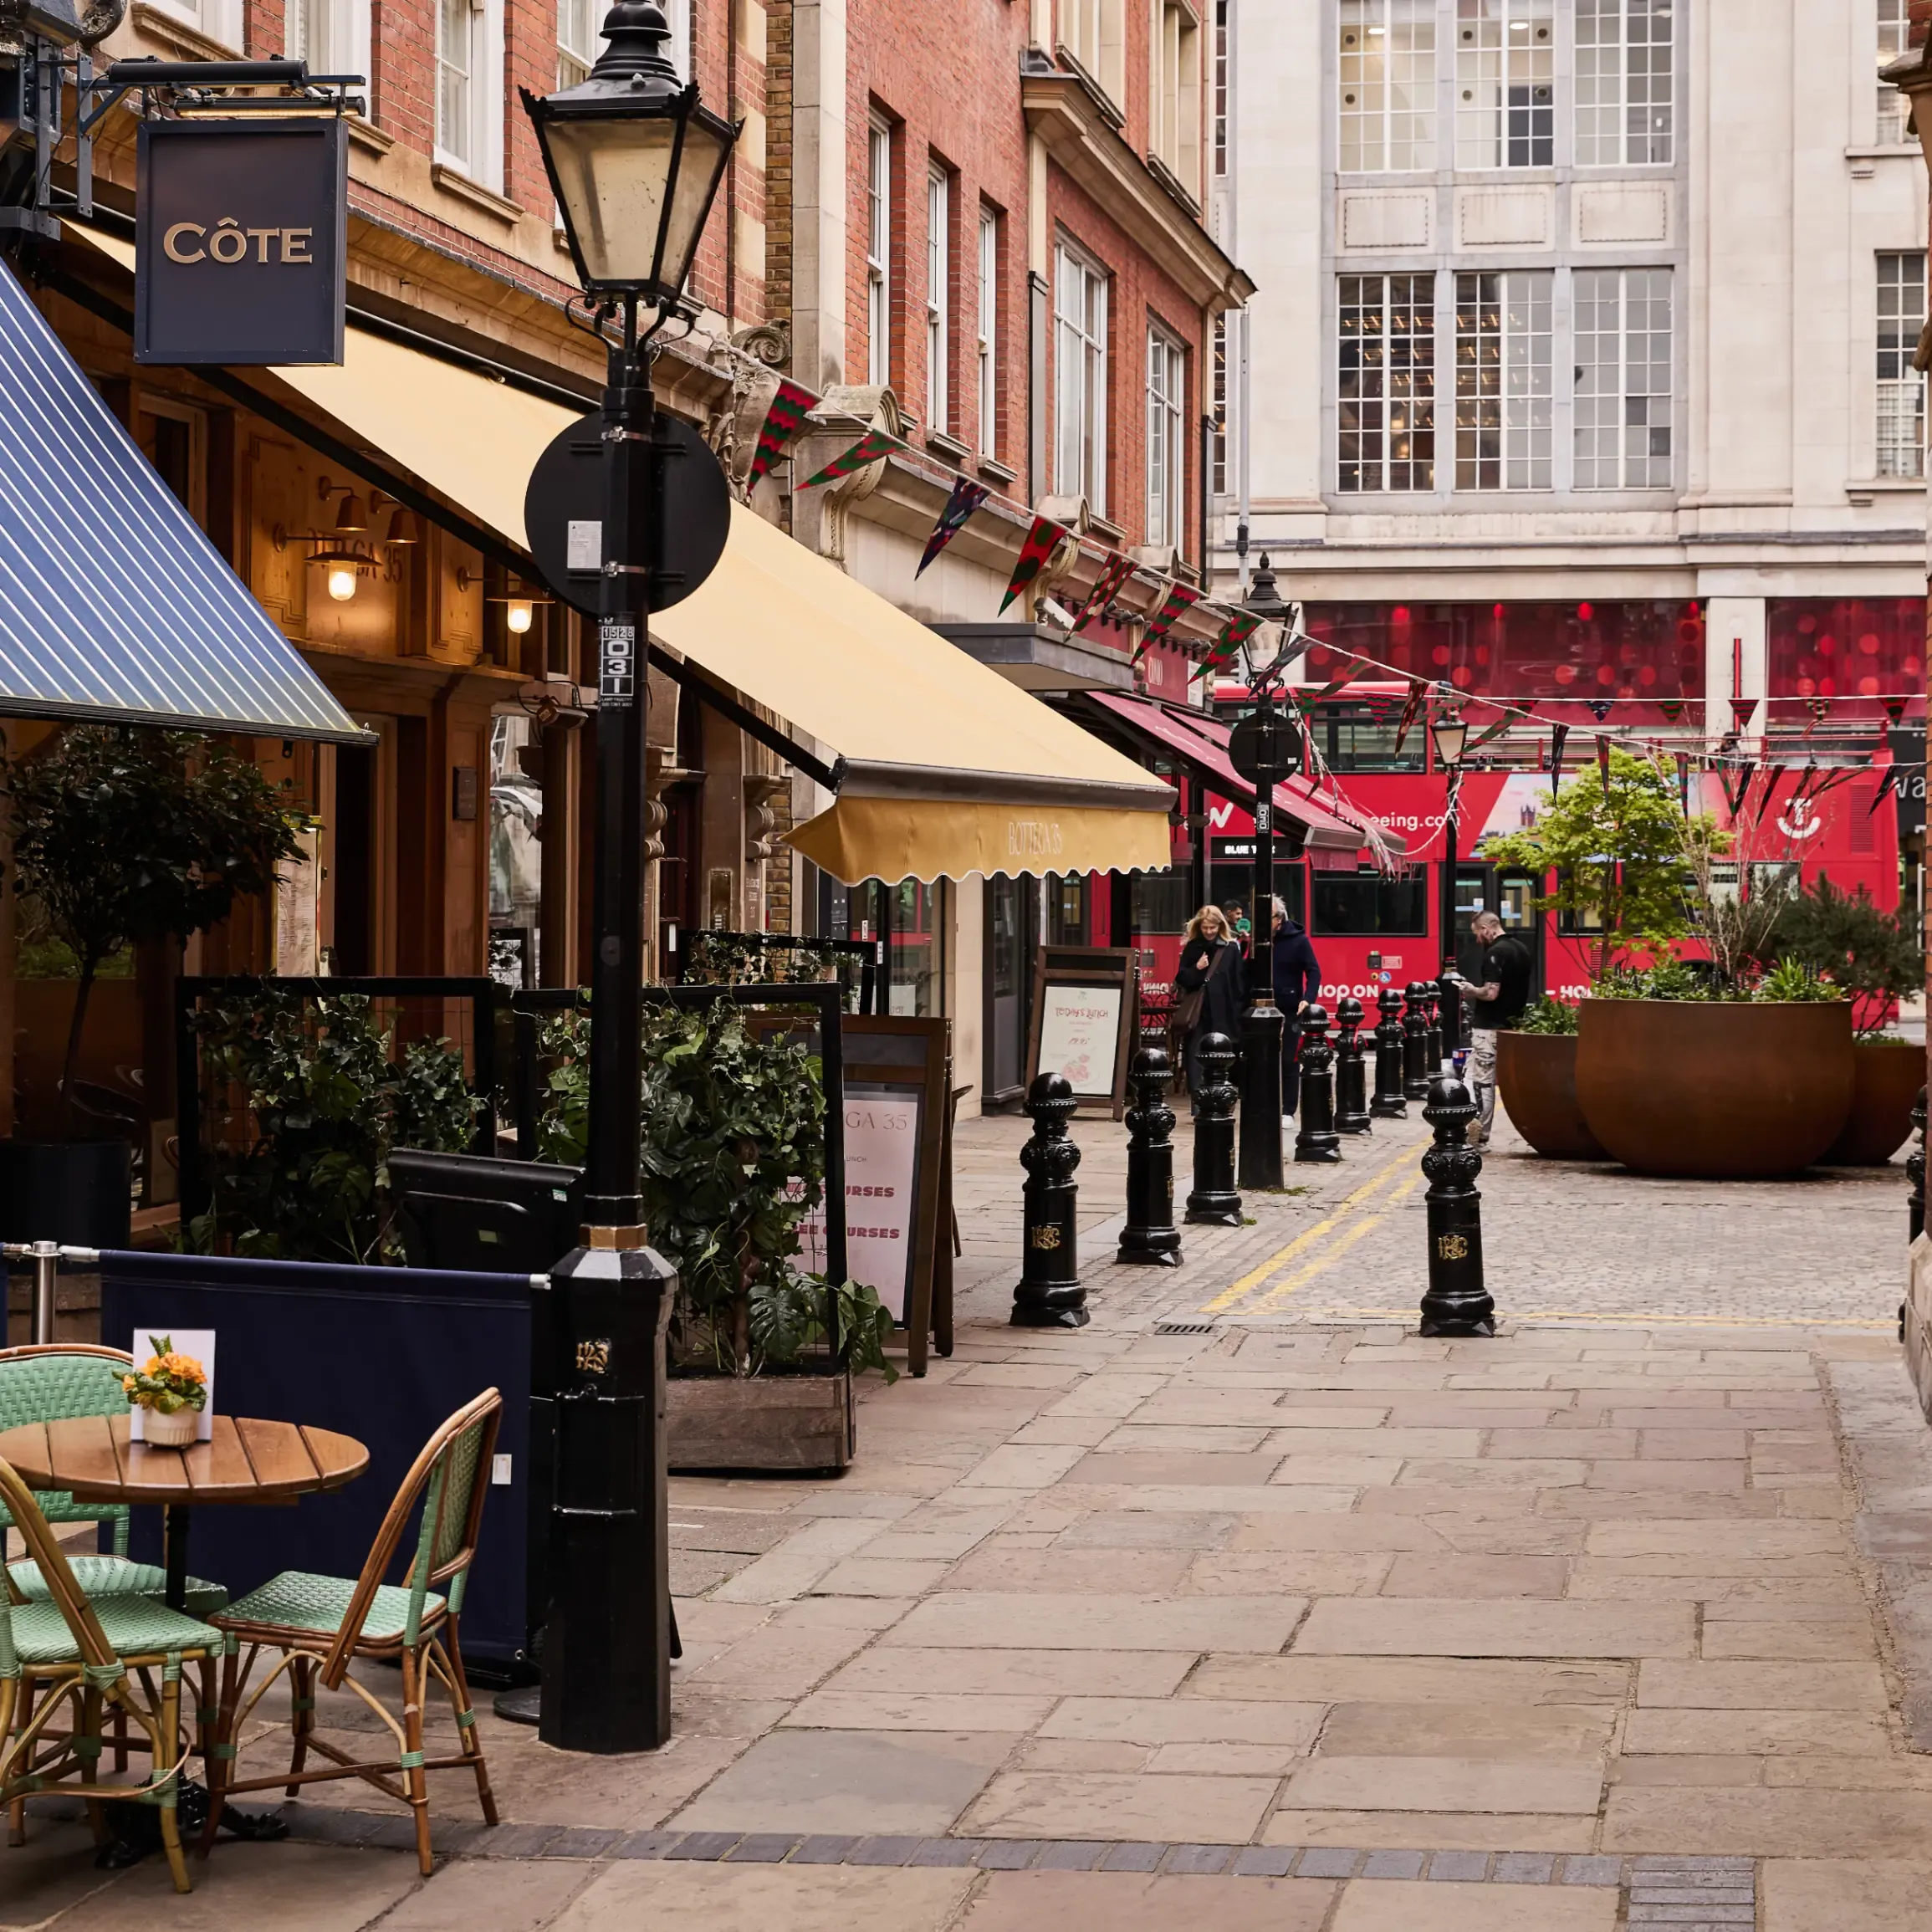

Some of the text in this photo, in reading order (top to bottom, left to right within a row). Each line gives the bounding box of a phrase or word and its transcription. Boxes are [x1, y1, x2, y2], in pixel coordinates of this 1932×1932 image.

[164, 217, 313, 264] CÔTE
[604, 628, 634, 638] 1528
[1009, 822, 1051, 855] BOTTEGA
[1224, 846, 1250, 854] BLUE
[1352, 984, 1378, 998] ON
[846, 1111, 907, 1130] GA 35
